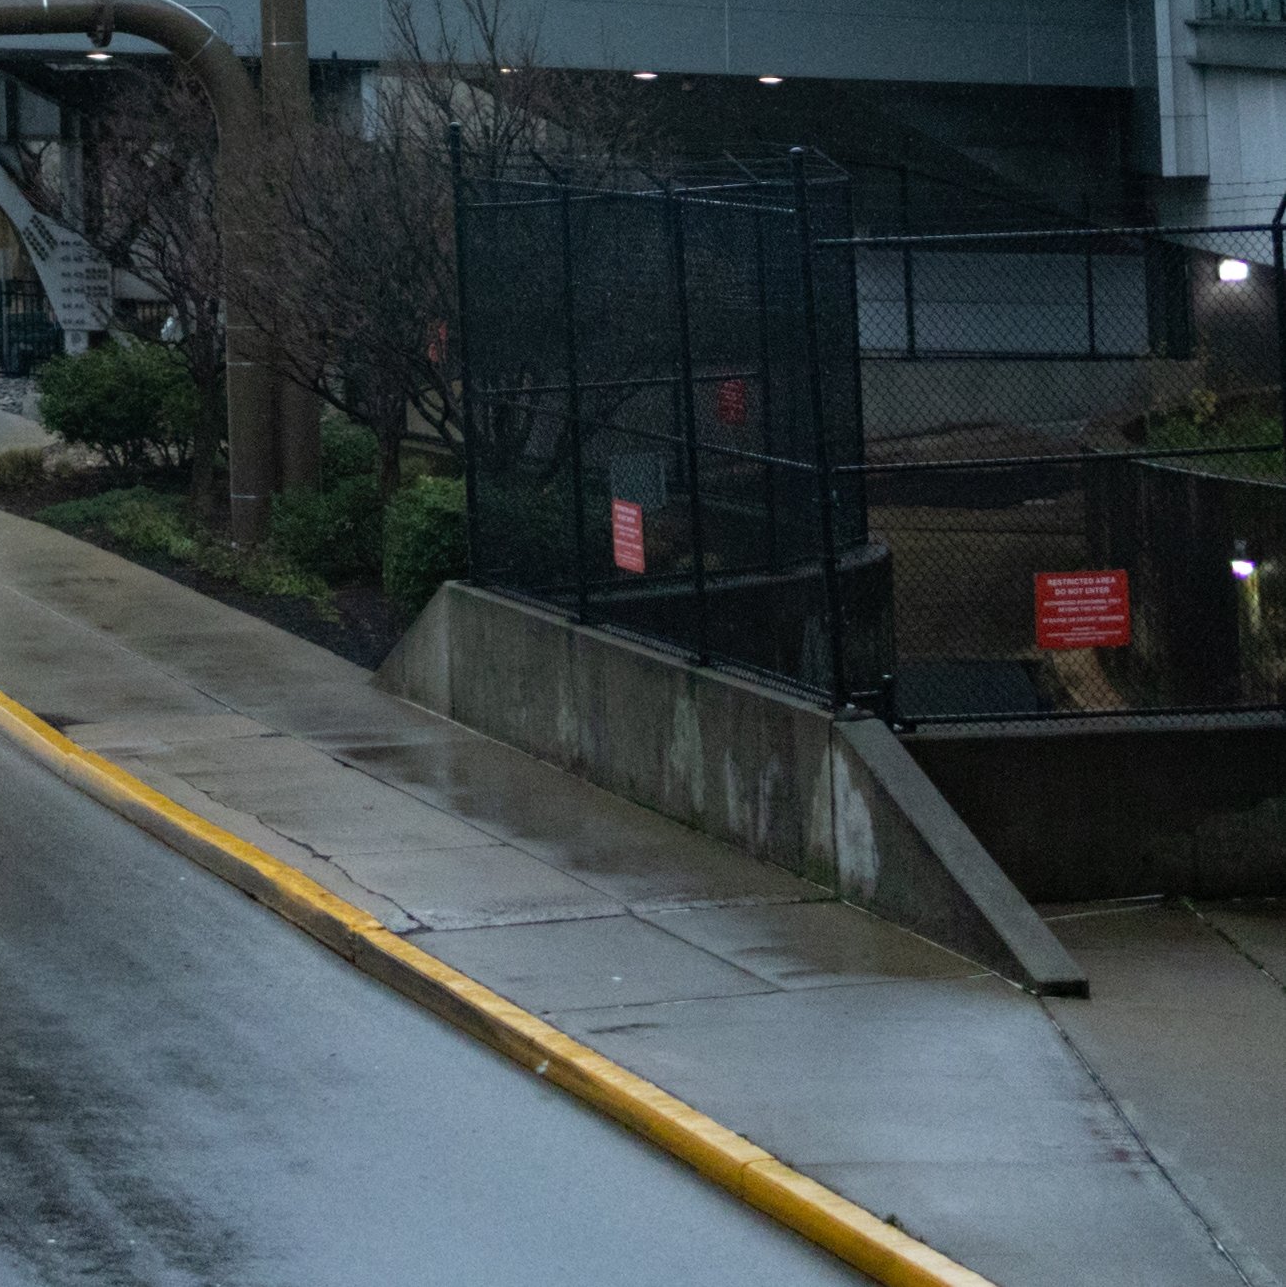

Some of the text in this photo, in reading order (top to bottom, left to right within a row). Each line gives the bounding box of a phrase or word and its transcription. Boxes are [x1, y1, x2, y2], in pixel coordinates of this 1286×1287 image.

[1047, 576, 1116, 586] RESTRICTED AREA
[1067, 587, 1083, 595] NOT
[1085, 586, 1110, 595] ENTER
